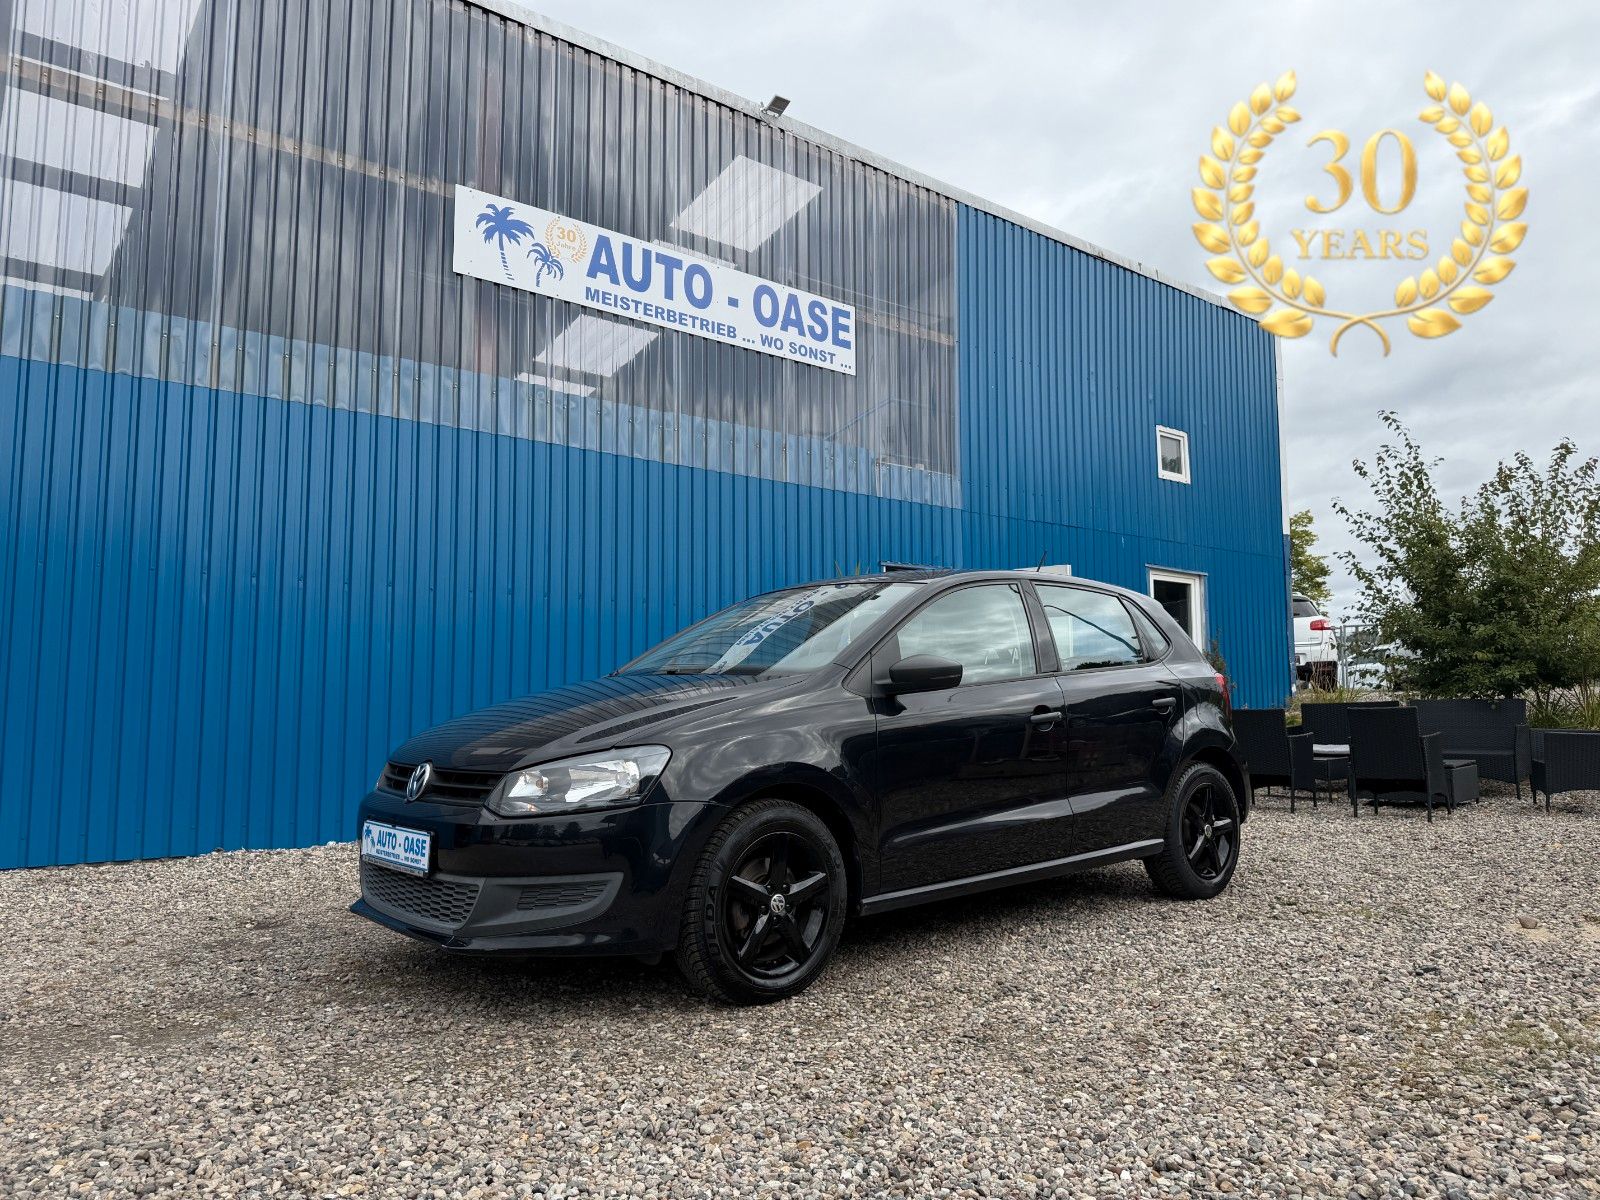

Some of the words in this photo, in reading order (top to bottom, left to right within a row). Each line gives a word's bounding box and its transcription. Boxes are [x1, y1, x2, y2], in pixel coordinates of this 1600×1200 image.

[557, 226, 576, 243] 30
[586, 234, 713, 310] AUTO
[753, 284, 851, 350] OASE
[585, 286, 737, 339] MEISTERBETRIEB
[760, 334, 784, 351] WO
[789, 342, 836, 364] SONST
[377, 829, 397, 850] AUTO
[403, 835, 427, 858] OASE
